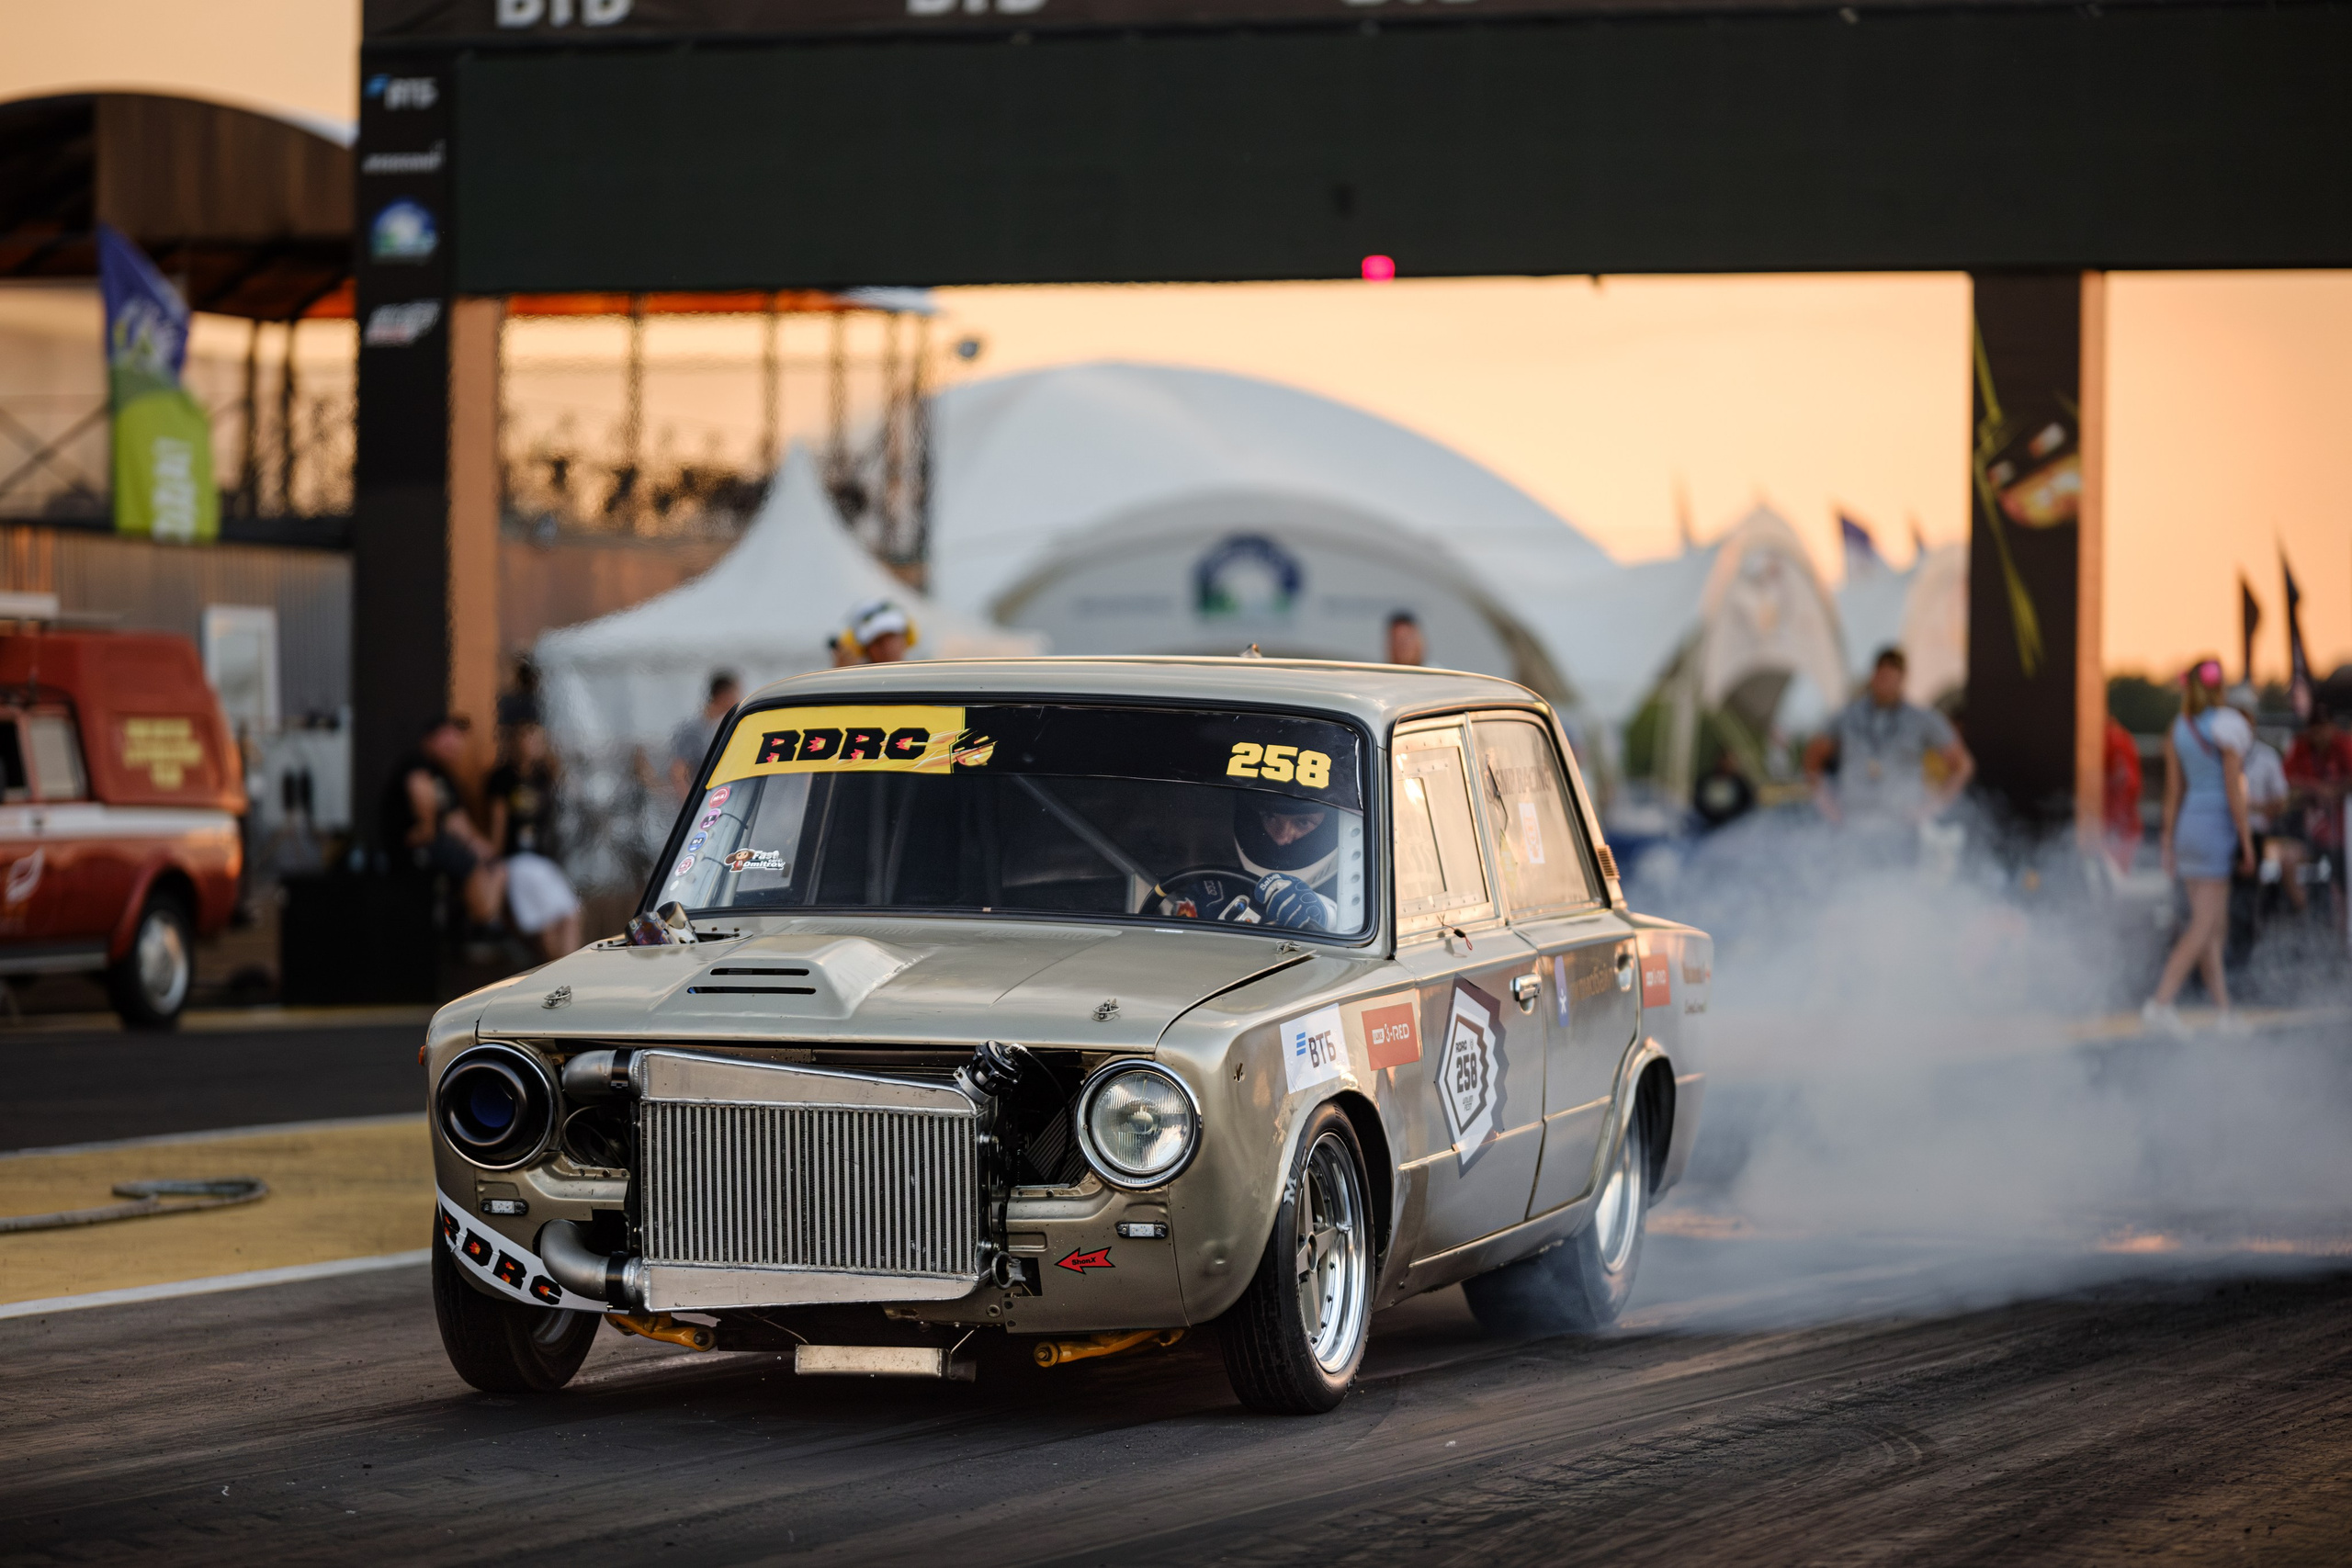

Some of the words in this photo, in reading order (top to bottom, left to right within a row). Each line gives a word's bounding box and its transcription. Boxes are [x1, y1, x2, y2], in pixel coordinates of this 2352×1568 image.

[754, 727, 931, 764] RDRC
[1226, 741, 1332, 789] 258
[752, 850, 780, 860] Fast
[1307, 1030, 1337, 1068] ВТБ
[1456, 1052, 1477, 1093] 258
[440, 1201, 563, 1305] RDRC
